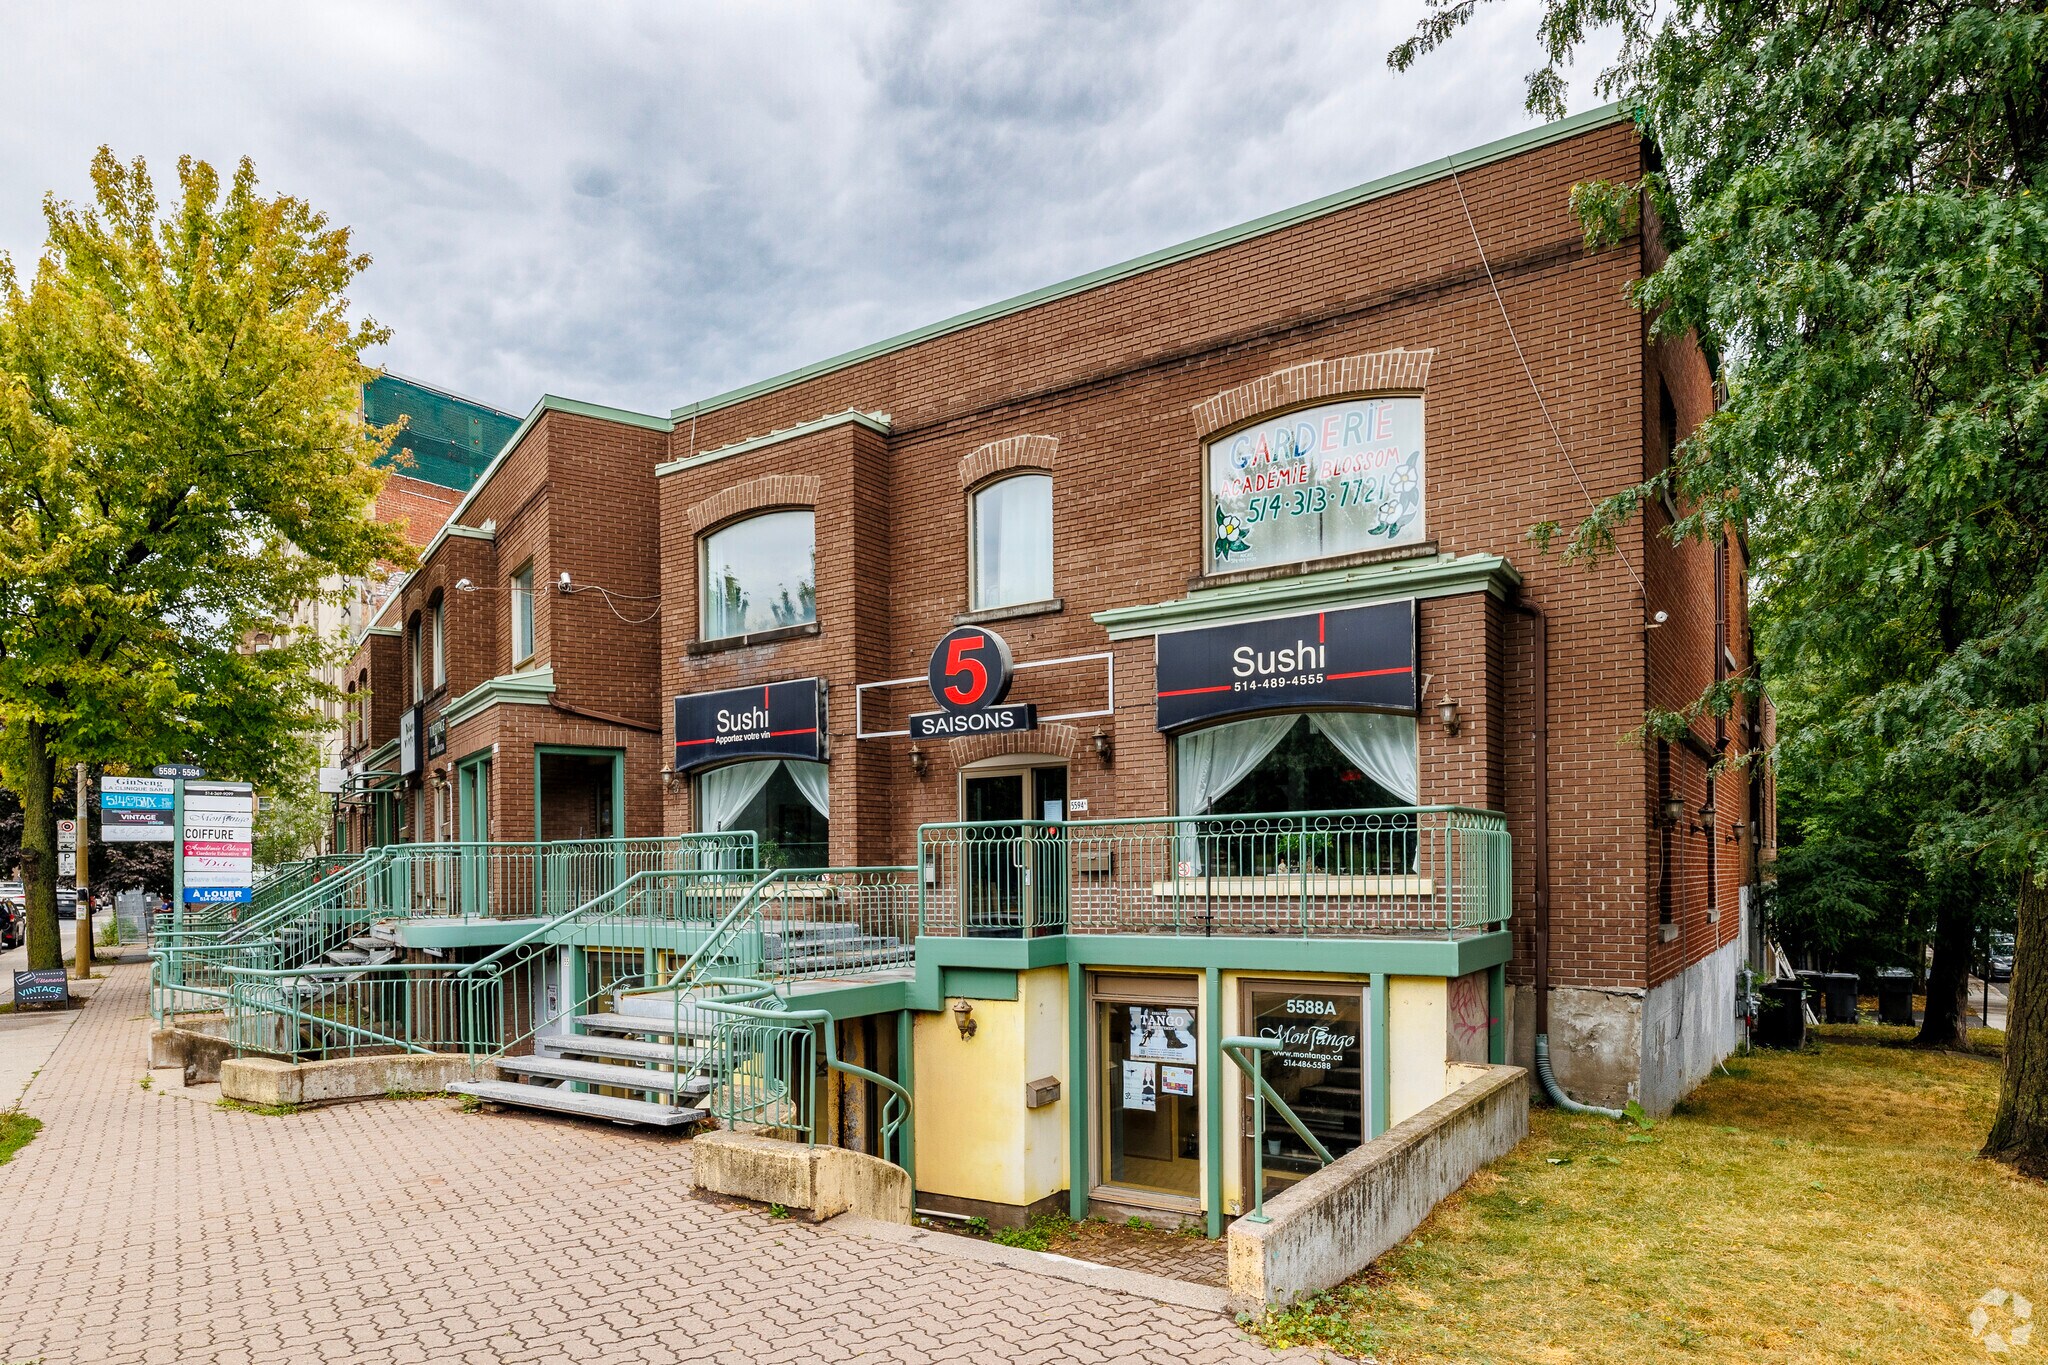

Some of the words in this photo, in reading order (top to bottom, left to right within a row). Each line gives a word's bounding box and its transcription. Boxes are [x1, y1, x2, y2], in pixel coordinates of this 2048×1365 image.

[1230, 404, 1392, 470] GARDERIE
[1220, 463, 1309, 498] ACADÉMIE
[1321, 447, 1400, 479] BLOSSOM
[1232, 639, 1325, 678] Sushi
[943, 635, 988, 705] 5
[1233, 673, 1324, 692] 514-489-4555
[716, 705, 769, 733] Sushi
[921, 710, 1014, 736] SAISONS
[715, 735, 743, 746] Apportez
[743, 732, 760, 742] votre
[760, 730, 771, 740] vin
[158, 767, 177, 776] 5580
[182, 768, 200, 777] 5594
[116, 778, 163, 788] GinSeng
[105, 795, 126, 807] 514
[185, 828, 234, 840] COIFFURE
[64, 853, 71, 862] P
[192, 889, 200, 898] À
[204, 890, 242, 898] LOUER
[18, 985, 63, 997] VINTAGE
[1286, 999, 1337, 1016] 5588A
[1140, 1014, 1184, 1027] TANGO
[1260, 1024, 1355, 1053] MonTango
[1272, 1050, 1343, 1061] www.montango.ca
[1283, 1059, 1331, 1070] 514-486-5588
